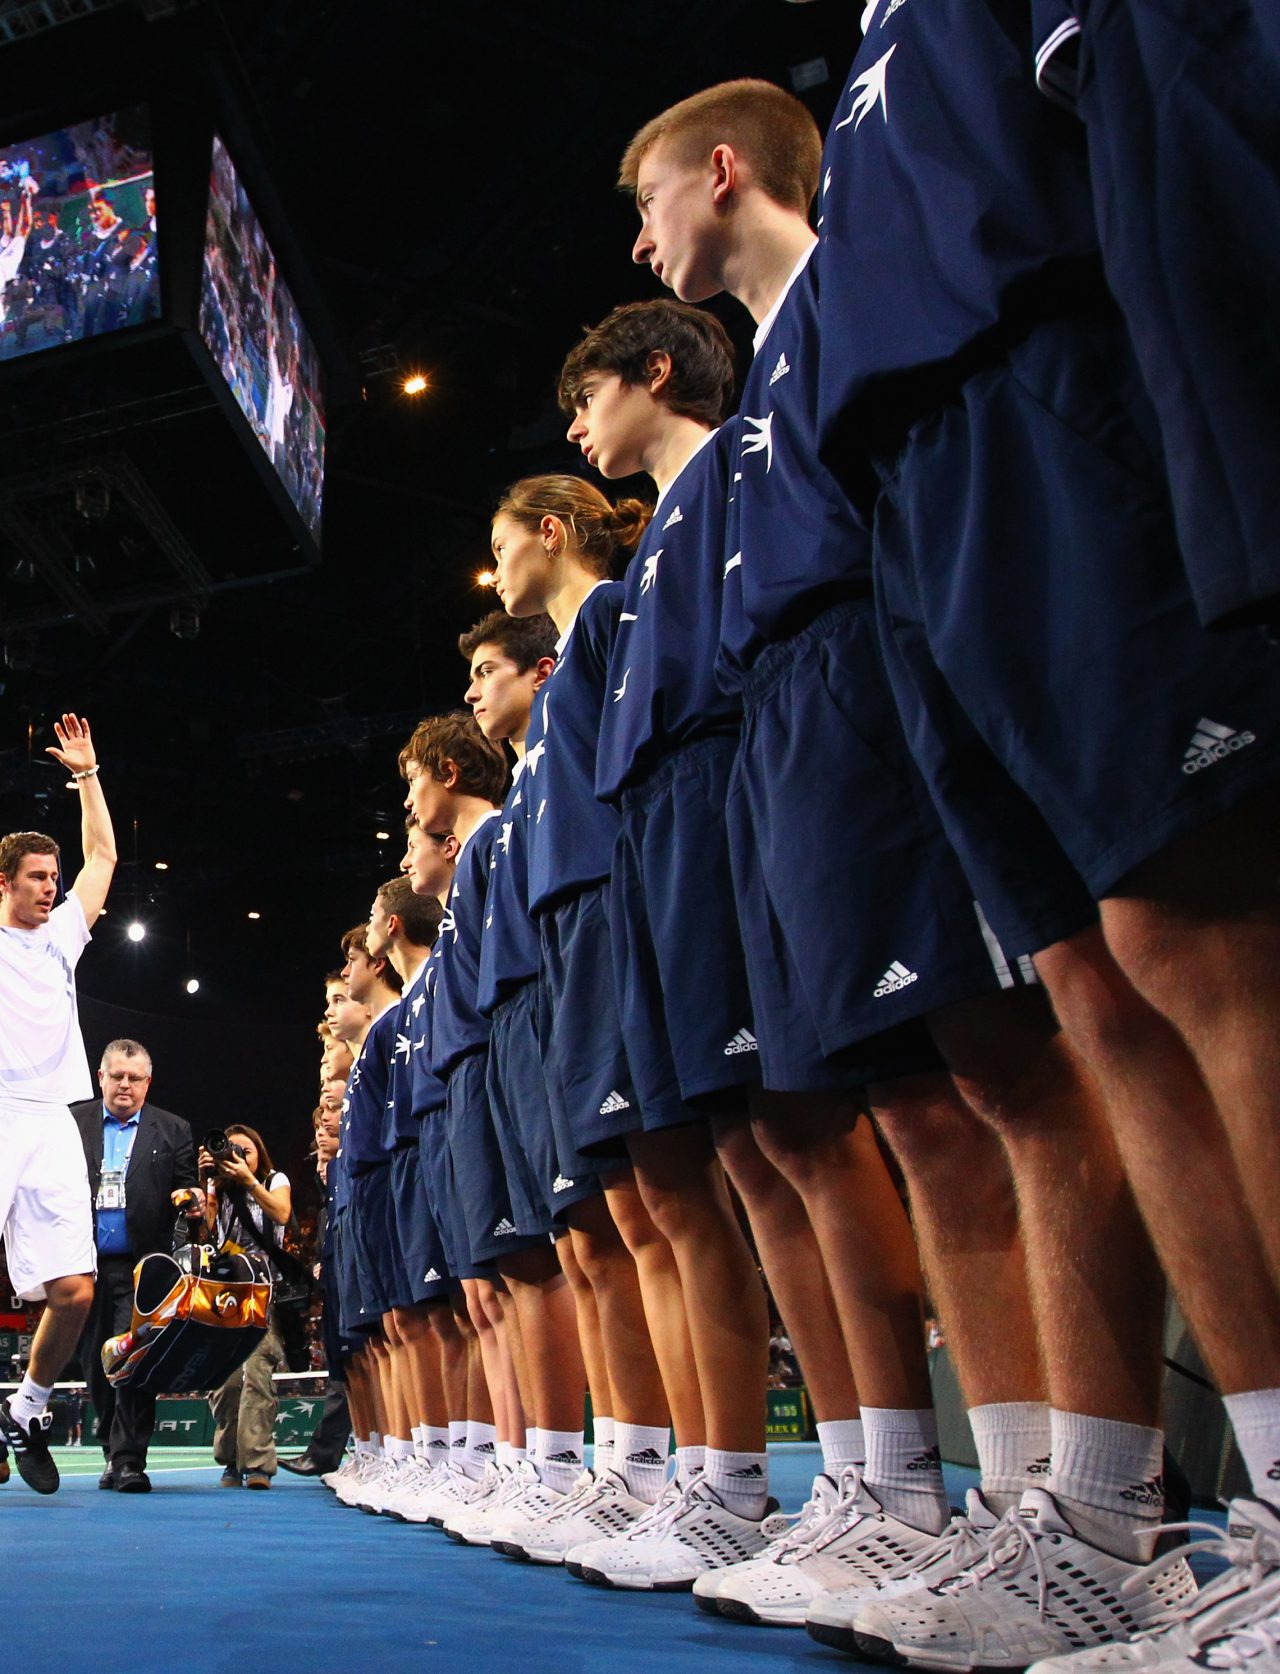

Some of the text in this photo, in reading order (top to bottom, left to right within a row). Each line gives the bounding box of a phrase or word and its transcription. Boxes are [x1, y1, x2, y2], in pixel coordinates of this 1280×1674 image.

[1182, 730, 1257, 775] adidas
[873, 972, 918, 998] adidas
[724, 1042, 758, 1056] adida
[599, 1101, 630, 1115] adidas
